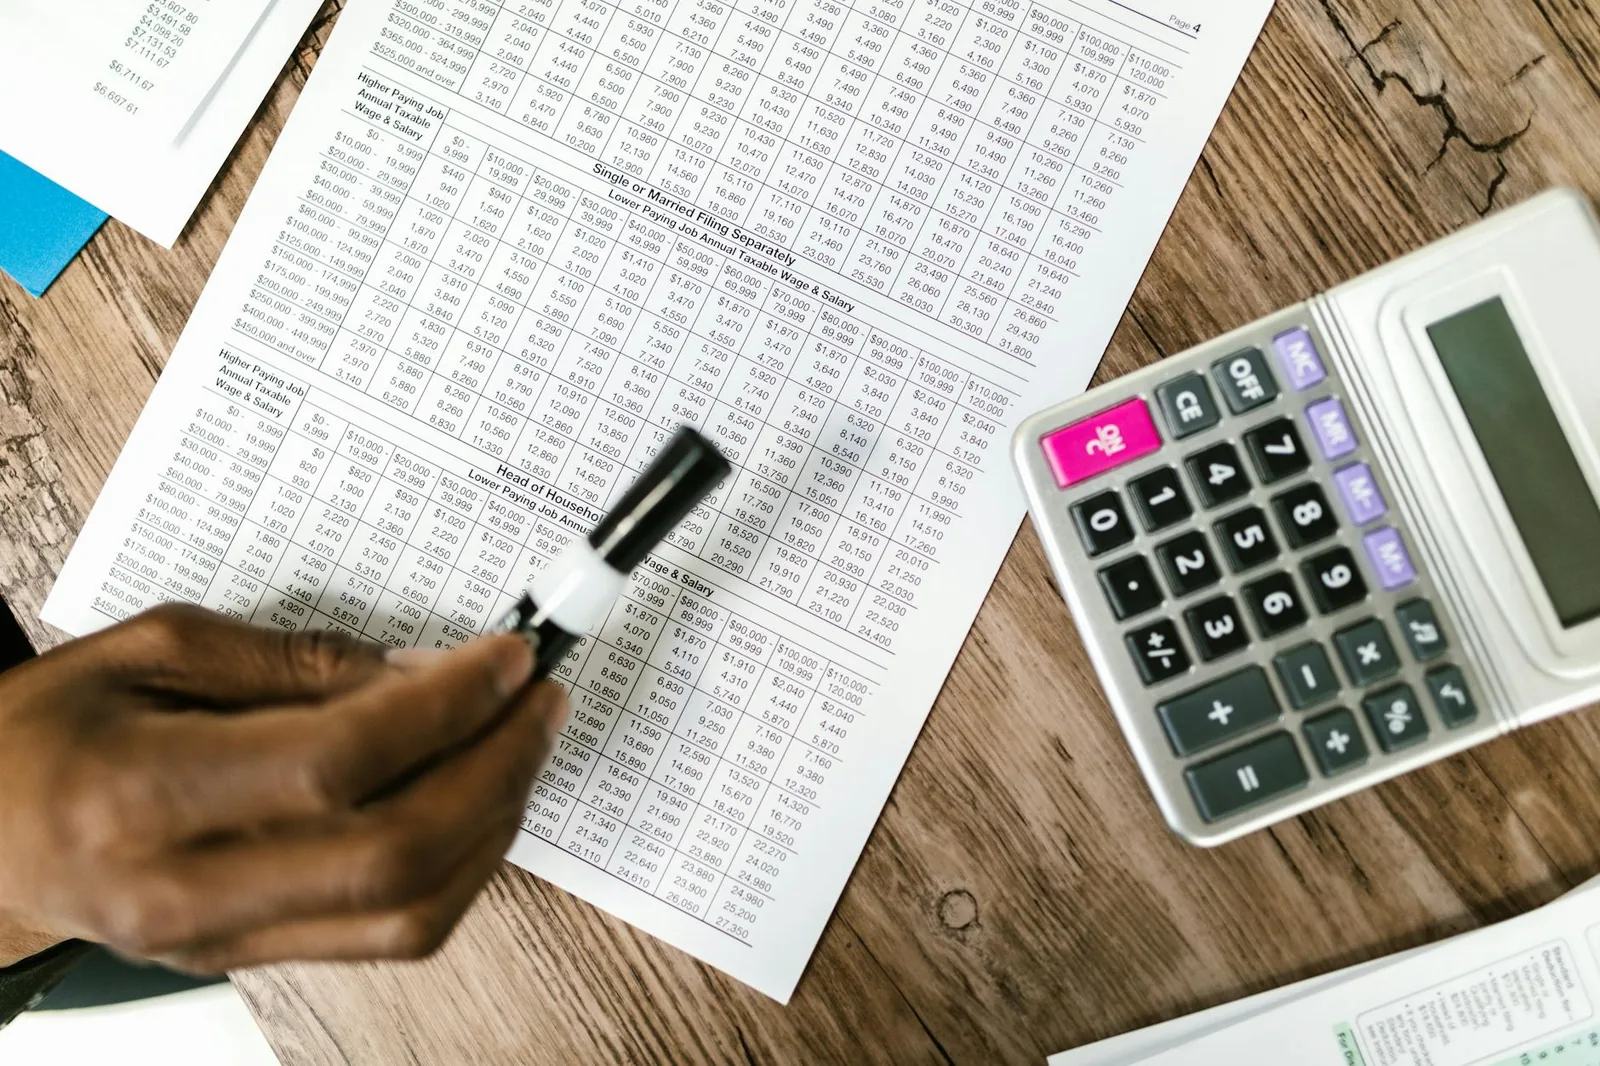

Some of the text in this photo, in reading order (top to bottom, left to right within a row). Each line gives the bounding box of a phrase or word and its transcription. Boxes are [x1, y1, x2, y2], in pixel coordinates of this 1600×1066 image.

[147, 4, 191, 36] $3,491.58
[155, 0, 198, 24] 3,607.80
[806, 12, 834, 31] 3,490
[140, 14, 184, 46] $4,098.20
[1030, 22, 1064, 44] 99,999
[1168, 14, 1202, 34] Page 4
[124, 37, 170, 68] $7,111.67
[132, 26, 176, 58] $7,131.53
[910, 43, 938, 61] 4,360
[1024, 40, 1058, 61] $1,100
[372, 41, 456, 87] $525,000 and over
[966, 50, 994, 68] 4,160
[1080, 45, 1115, 67] 109,999
[109, 60, 154, 92] $6,711.67
[1129, 67, 1165, 89] 120,000
[94, 82, 138, 114] $6,697.61
[356, 71, 444, 120] Higher Paying Job
[1122, 84, 1157, 106] $1,870
[357, 88, 431, 129] Annual Taxable
[583, 106, 610, 124] 8,780
[814, 105, 846, 126] 10,520
[354, 99, 423, 142] Wage & Salary
[522, 113, 549, 131] 6,840
[442, 145, 469, 163] 9,999
[619, 141, 651, 161] 12,130
[918, 136, 951, 157] 11,340
[1099, 146, 1128, 165] 8,260
[441, 164, 465, 182] $440
[848, 157, 880, 178] 12,830
[778, 179, 809, 200] 14,070
[1016, 181, 1049, 202] 13,260
[1081, 174, 1113, 195] 10,260
[953, 188, 985, 209] 15,230
[526, 205, 559, 227] $1,020
[592, 162, 797, 267] Single or Married Filing Separately
[882, 209, 914, 230] 16,470
[526, 223, 552, 241] 1,620
[1059, 219, 1091, 240] 15,290
[336, 240, 372, 263] 124,999
[607, 188, 856, 313] Lower Paying Job Annual Taxable Wage & Salary
[809, 230, 843, 252] 21,460
[987, 240, 1020, 262] 18,640
[621, 250, 654, 272] $1,410
[1044, 248, 1077, 270] 18,040
[724, 279, 757, 300] 69,999
[963, 284, 998, 306] 25,560
[899, 291, 934, 313] 28,030
[234, 317, 316, 363] $450,000 and over
[1005, 322, 1040, 345] 29,430
[583, 341, 610, 361] 7,490
[700, 343, 728, 363] 5,720
[998, 337, 1033, 360] 31,800
[1287, 341, 1316, 377] MC
[218, 348, 304, 397] Higher Paying Job
[756, 352, 785, 371] 4,720
[218, 364, 291, 406] Annual Taxable
[863, 365, 897, 388] $2,030
[1229, 359, 1264, 400] OFF
[215, 376, 284, 418] Wage & Salary
[382, 390, 409, 409] 6,250
[494, 390, 526, 411] 10,560
[1176, 391, 1202, 423] CE
[534, 428, 566, 450] 12,860
[1096, 424, 1126, 456] ON
[1264, 434, 1295, 454] 7
[347, 465, 372, 483] $820
[820, 456, 853, 478] 10,390
[1209, 463, 1235, 485] 4
[467, 468, 594, 537] Lower Paying Job Annua
[495, 463, 604, 523] Head of Househol
[742, 492, 774, 514] 17,750
[805, 486, 838, 508] 15,050
[930, 491, 959, 510] 9,990
[1150, 486, 1176, 505] 1
[1090, 509, 1118, 532] 0
[1293, 500, 1322, 526] 8
[1234, 525, 1265, 548] 5
[300, 553, 327, 572] 4,280
[710, 552, 744, 575] 20,290
[894, 548, 929, 571] 20,010
[1175, 550, 1205, 575] 2
[409, 571, 436, 590] 4,790
[670, 568, 680, 580] &
[680, 573, 715, 598] Salary
[1321, 565, 1351, 589] 9
[632, 585, 665, 608] 79,999
[1263, 591, 1293, 615] 6
[269, 612, 297, 632] 5,920
[624, 603, 659, 626] $1,870
[865, 609, 899, 632] 22,520
[1204, 614, 1234, 639] 3
[379, 629, 407, 650] 7,240
[607, 651, 636, 671] 6,630
[720, 670, 748, 690] 4,310
[637, 703, 669, 726] 11,050
[1208, 701, 1233, 725] +
[1384, 701, 1411, 733] %
[607, 764, 640, 787] 18,640
[671, 759, 703, 781] 14,690
[582, 809, 617, 833] 21,340
[745, 854, 780, 877] 24,020
[715, 916, 749, 939] 27,350
